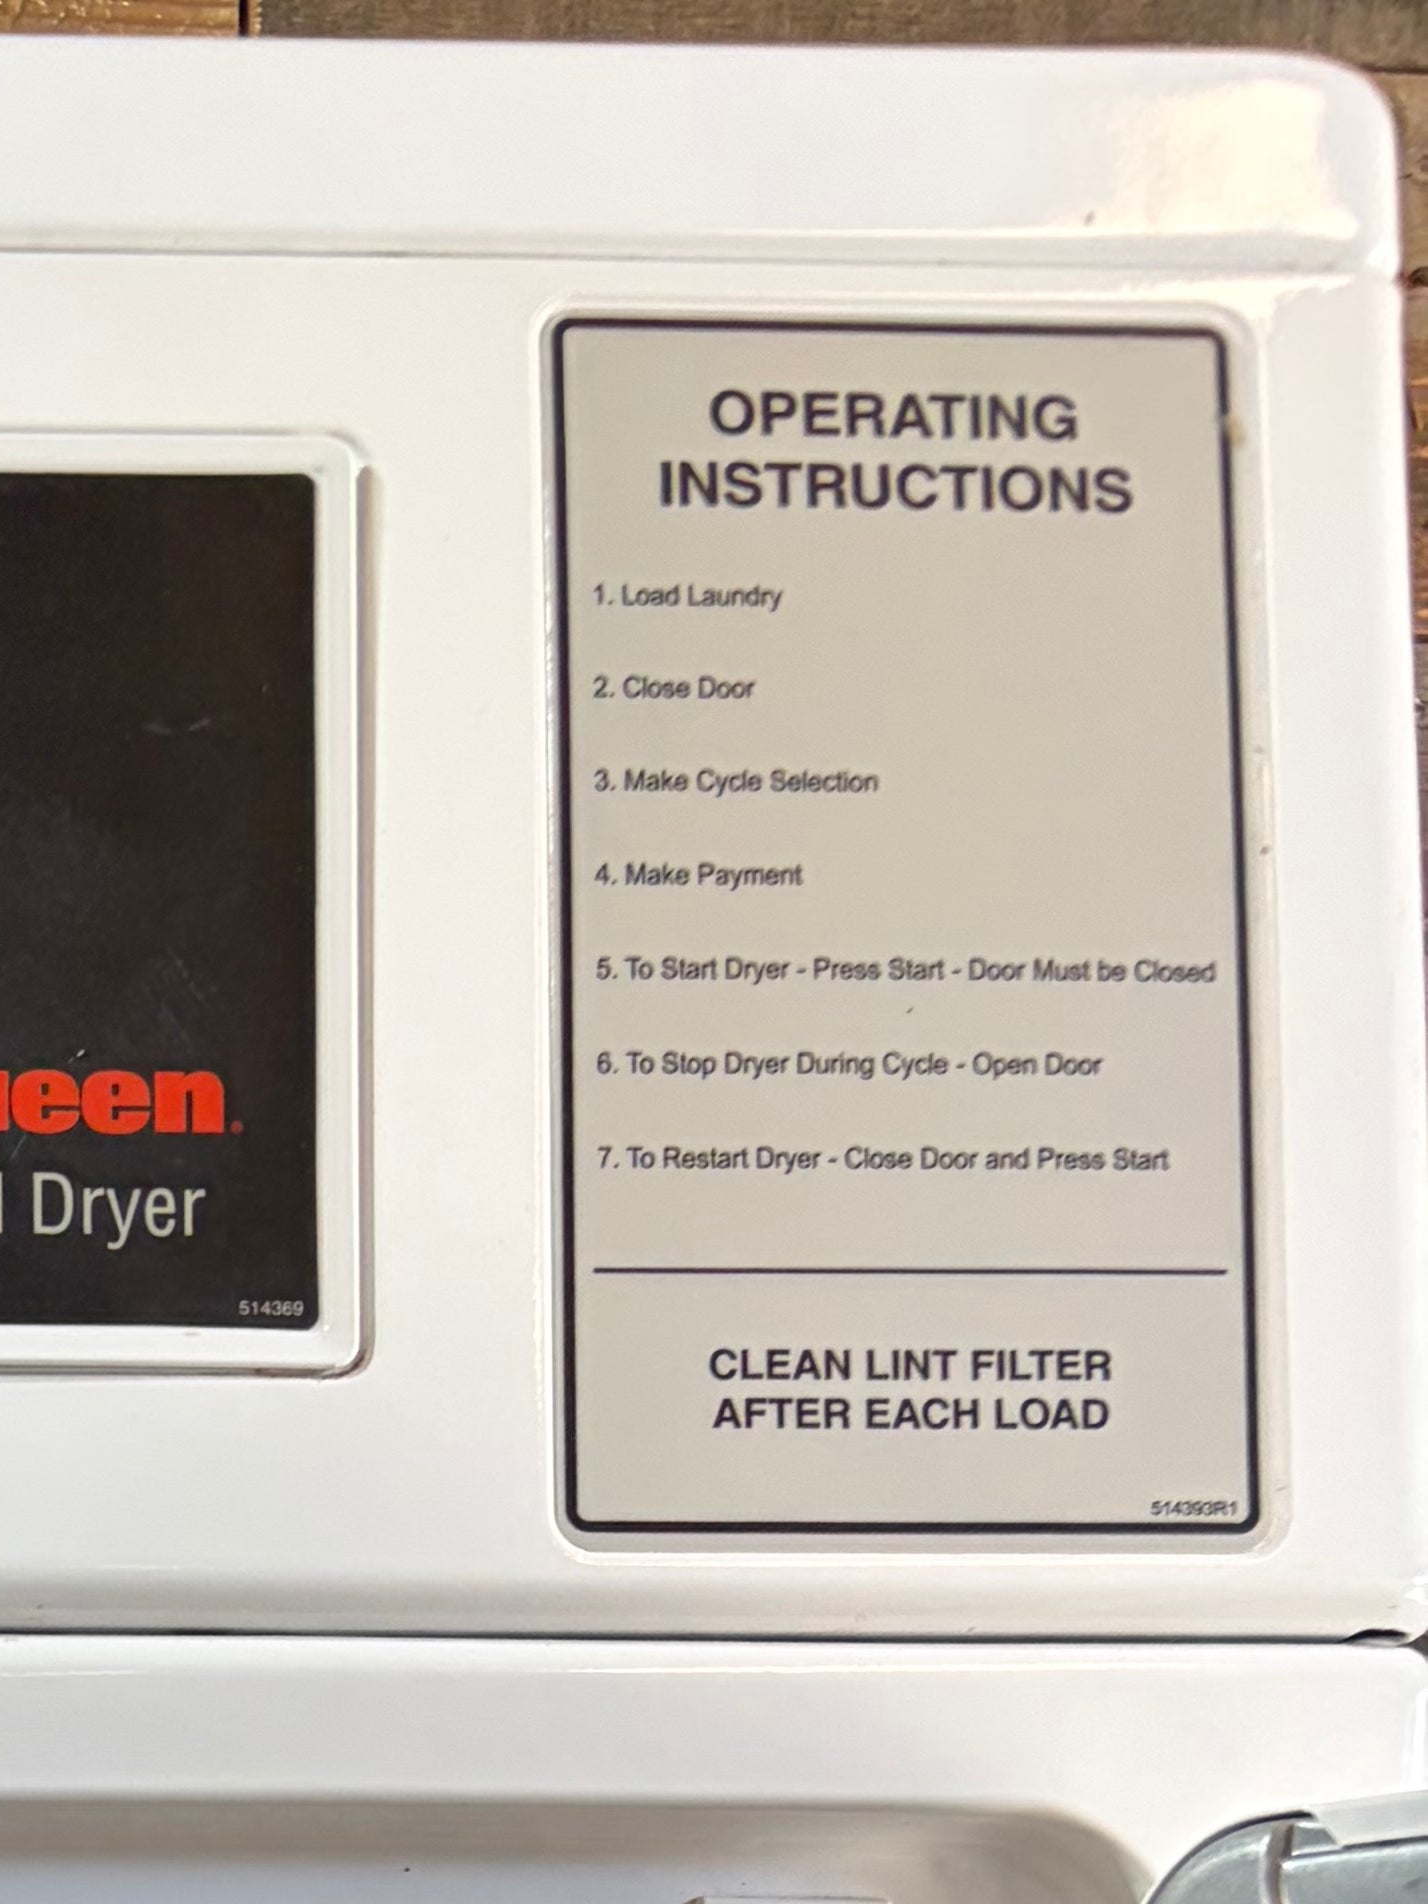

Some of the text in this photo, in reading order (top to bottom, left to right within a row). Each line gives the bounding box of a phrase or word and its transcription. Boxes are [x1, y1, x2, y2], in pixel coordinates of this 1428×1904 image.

[710, 390, 1076, 440] OPERATING
[661, 461, 1132, 513] INSTRUCTIONS
[594, 584, 782, 612] 1. Load Laundry
[594, 675, 755, 699] 2. Close Door
[594, 768, 878, 797] 3. Make Cycle Selection
[594, 862, 802, 891] 4. Make Payment
[596, 956, 1216, 985] 5. To Start Dryer Press Start Door Must be Closed
[597, 1051, 1102, 1080] 6. To Stop Dryer During Cycle Open Door
[598, 1146, 1169, 1174] 7. To Restart Dryer Close Door and Press Start
[33, 1172, 206, 1250] Dryer
[239, 1300, 304, 1316] 514369
[710, 1348, 1110, 1380] CLEAN LINT FILTER
[713, 1398, 1109, 1429] AFTER EACH LOAD
